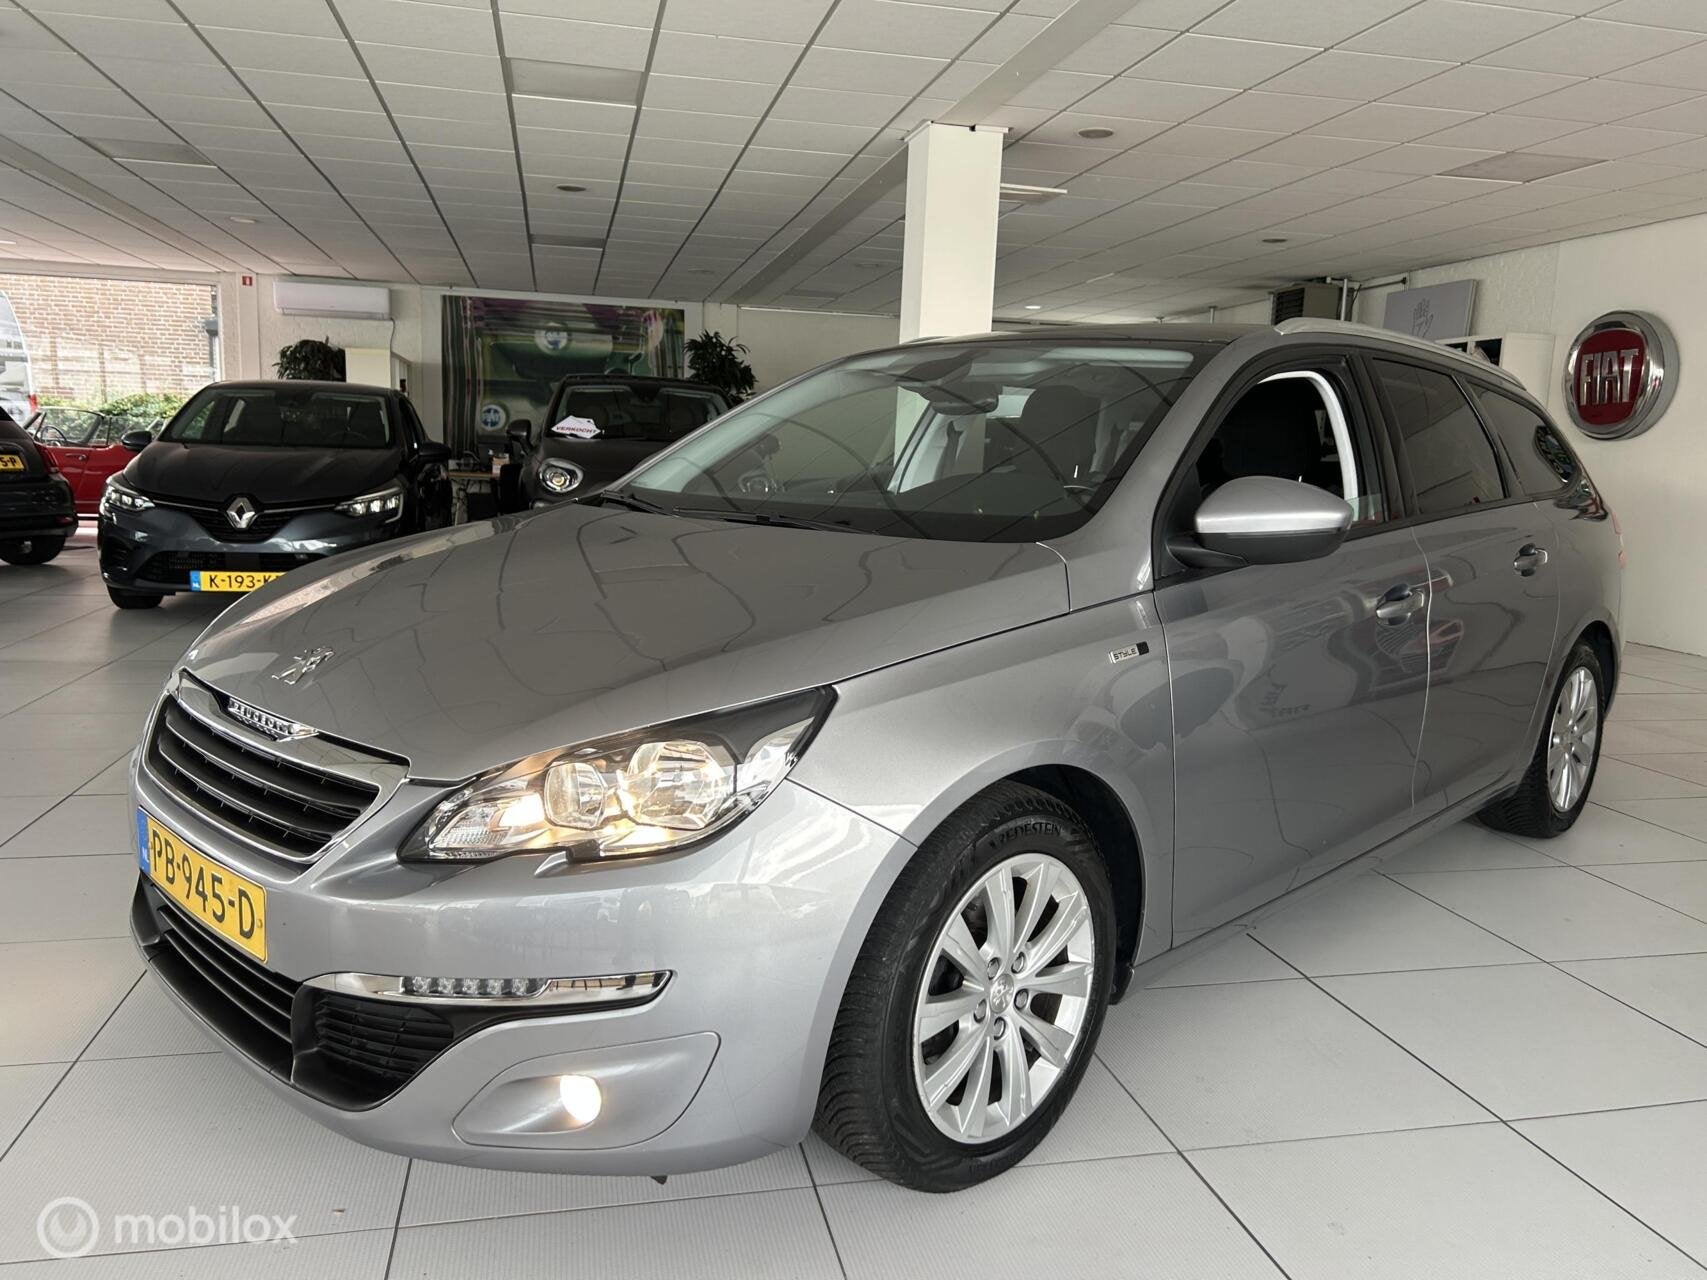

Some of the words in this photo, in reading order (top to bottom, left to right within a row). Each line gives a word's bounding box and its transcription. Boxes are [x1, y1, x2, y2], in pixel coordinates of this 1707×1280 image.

[1580, 350, 1639, 406] FIAT
[209, 575, 280, 588] K-193-K
[1113, 648, 1137, 660] STYLE
[152, 829, 256, 939] PB-945-D
